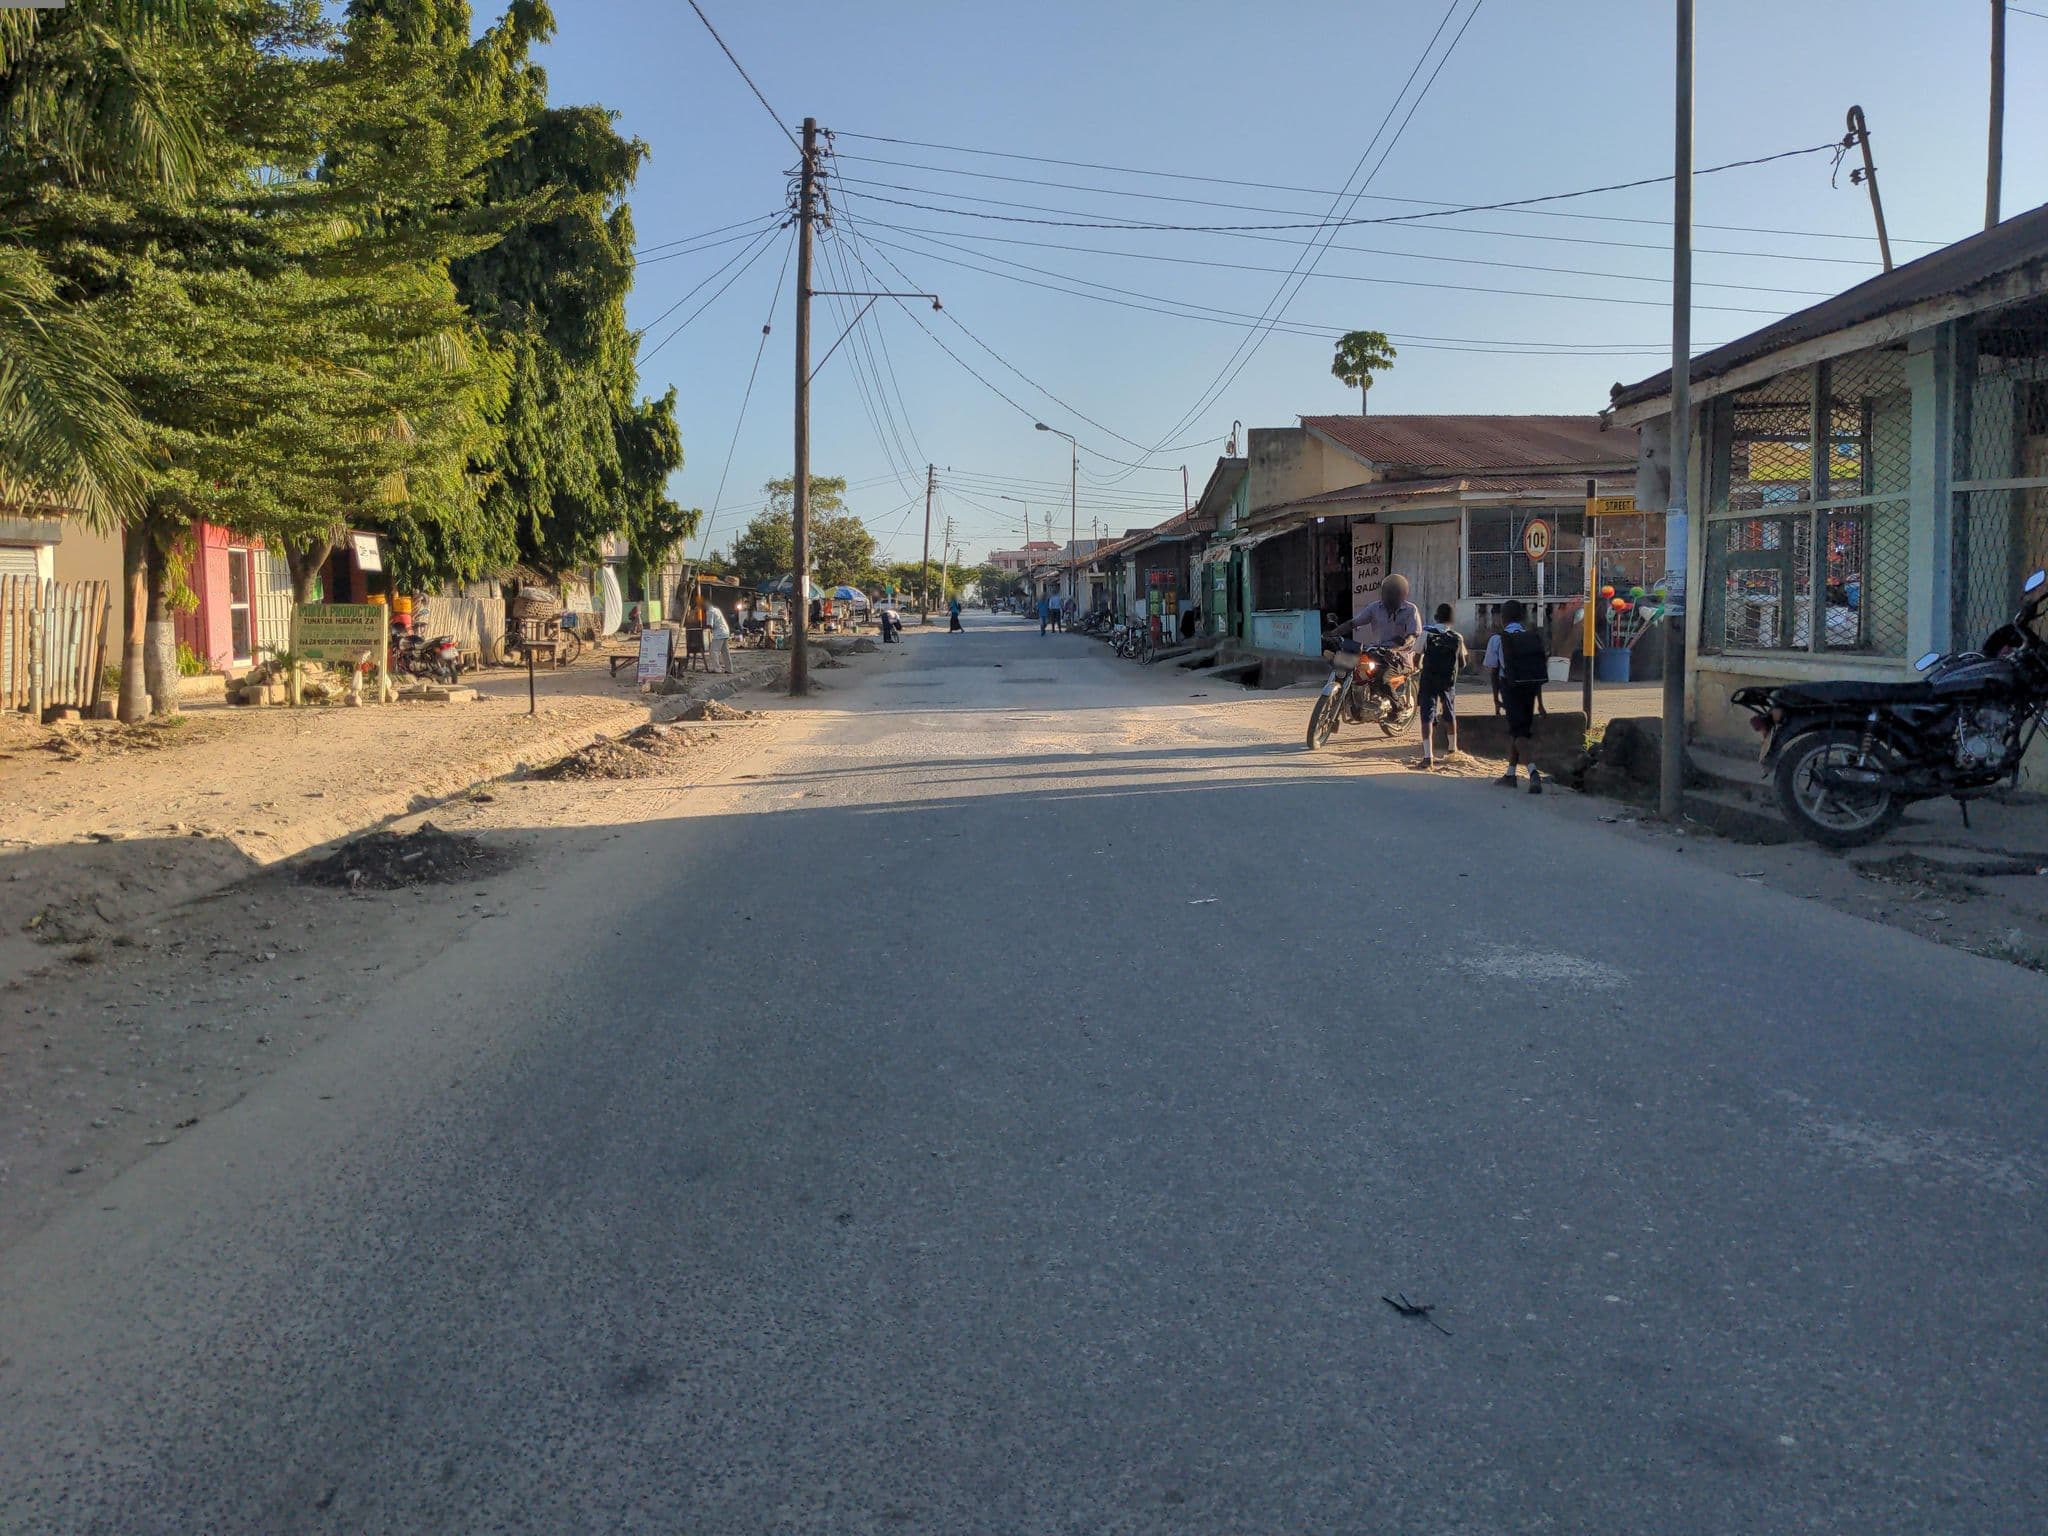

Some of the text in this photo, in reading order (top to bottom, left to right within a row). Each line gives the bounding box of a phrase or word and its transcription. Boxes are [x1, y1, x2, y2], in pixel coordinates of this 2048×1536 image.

[1605, 500, 1632, 511] STREET
[1528, 532, 1545, 548] 10t
[1358, 566, 1379, 579] HAIR
